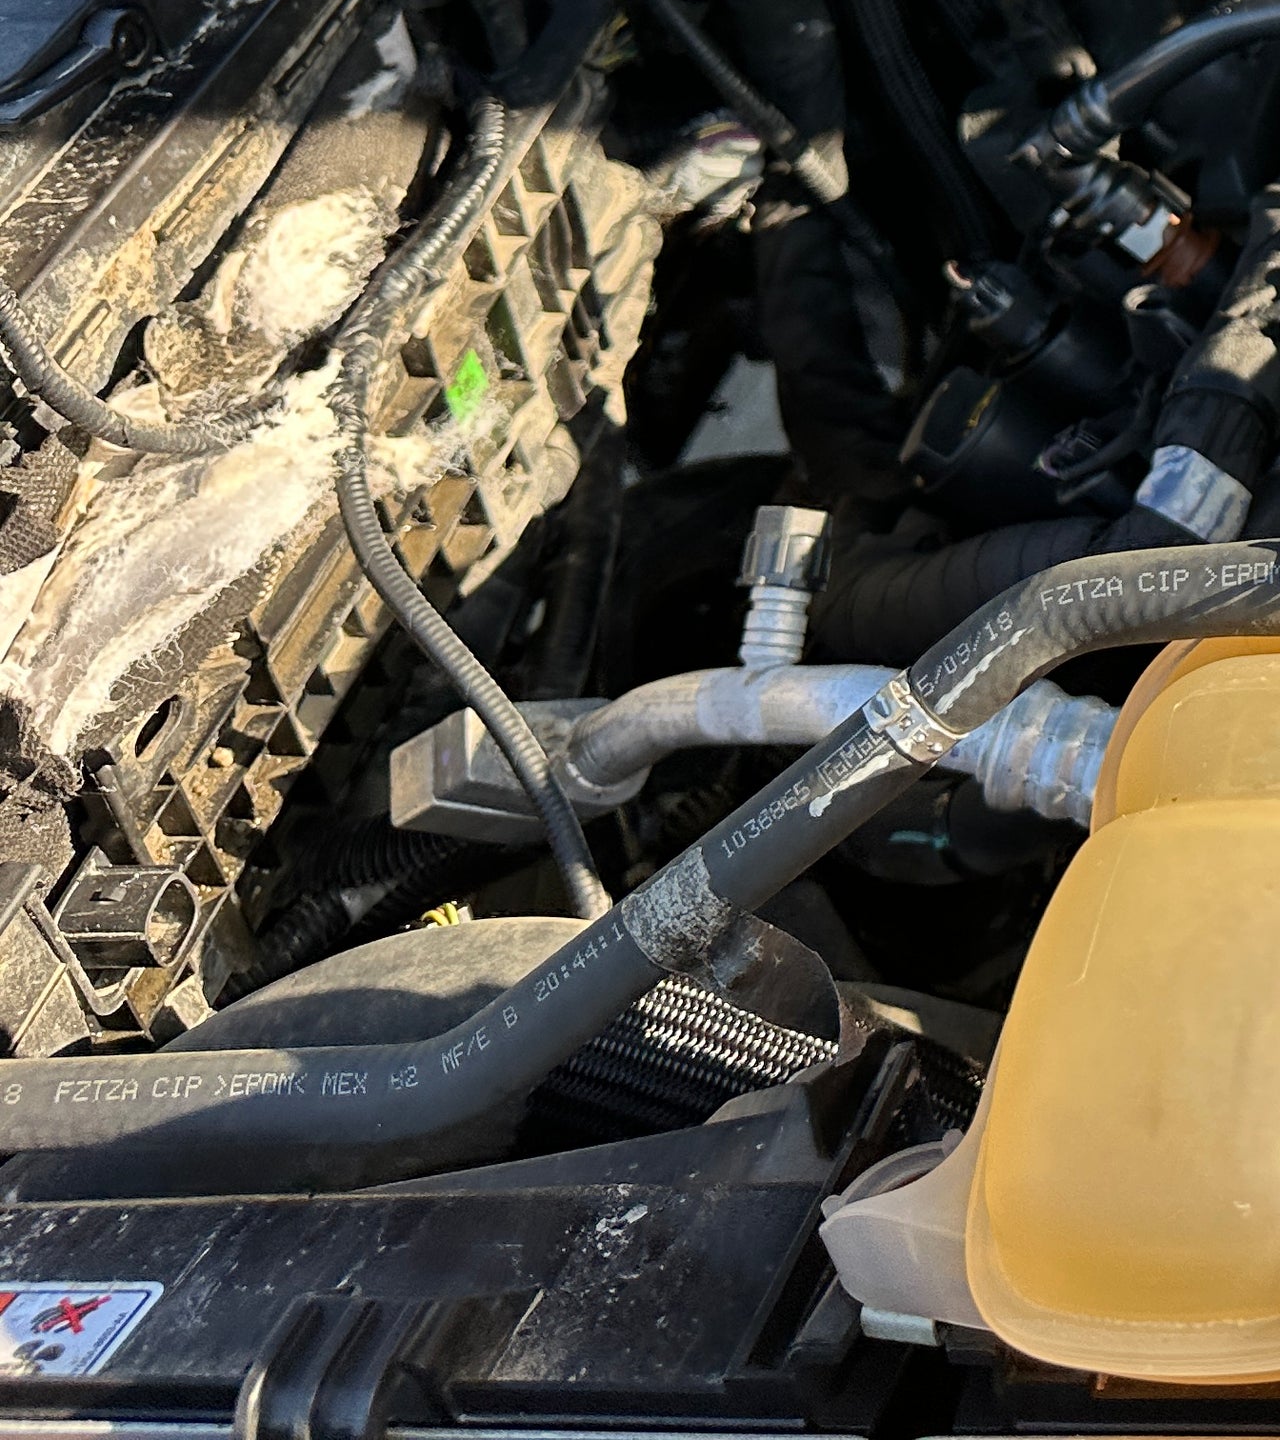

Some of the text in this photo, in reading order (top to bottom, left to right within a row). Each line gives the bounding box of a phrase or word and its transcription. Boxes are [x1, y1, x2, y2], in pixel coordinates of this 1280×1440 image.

[1137, 569, 1190, 592] CIP
[152, 1073, 203, 1099] CIP
[321, 1071, 369, 1096] MEX
[532, 921, 626, 1003] 20:44:1
